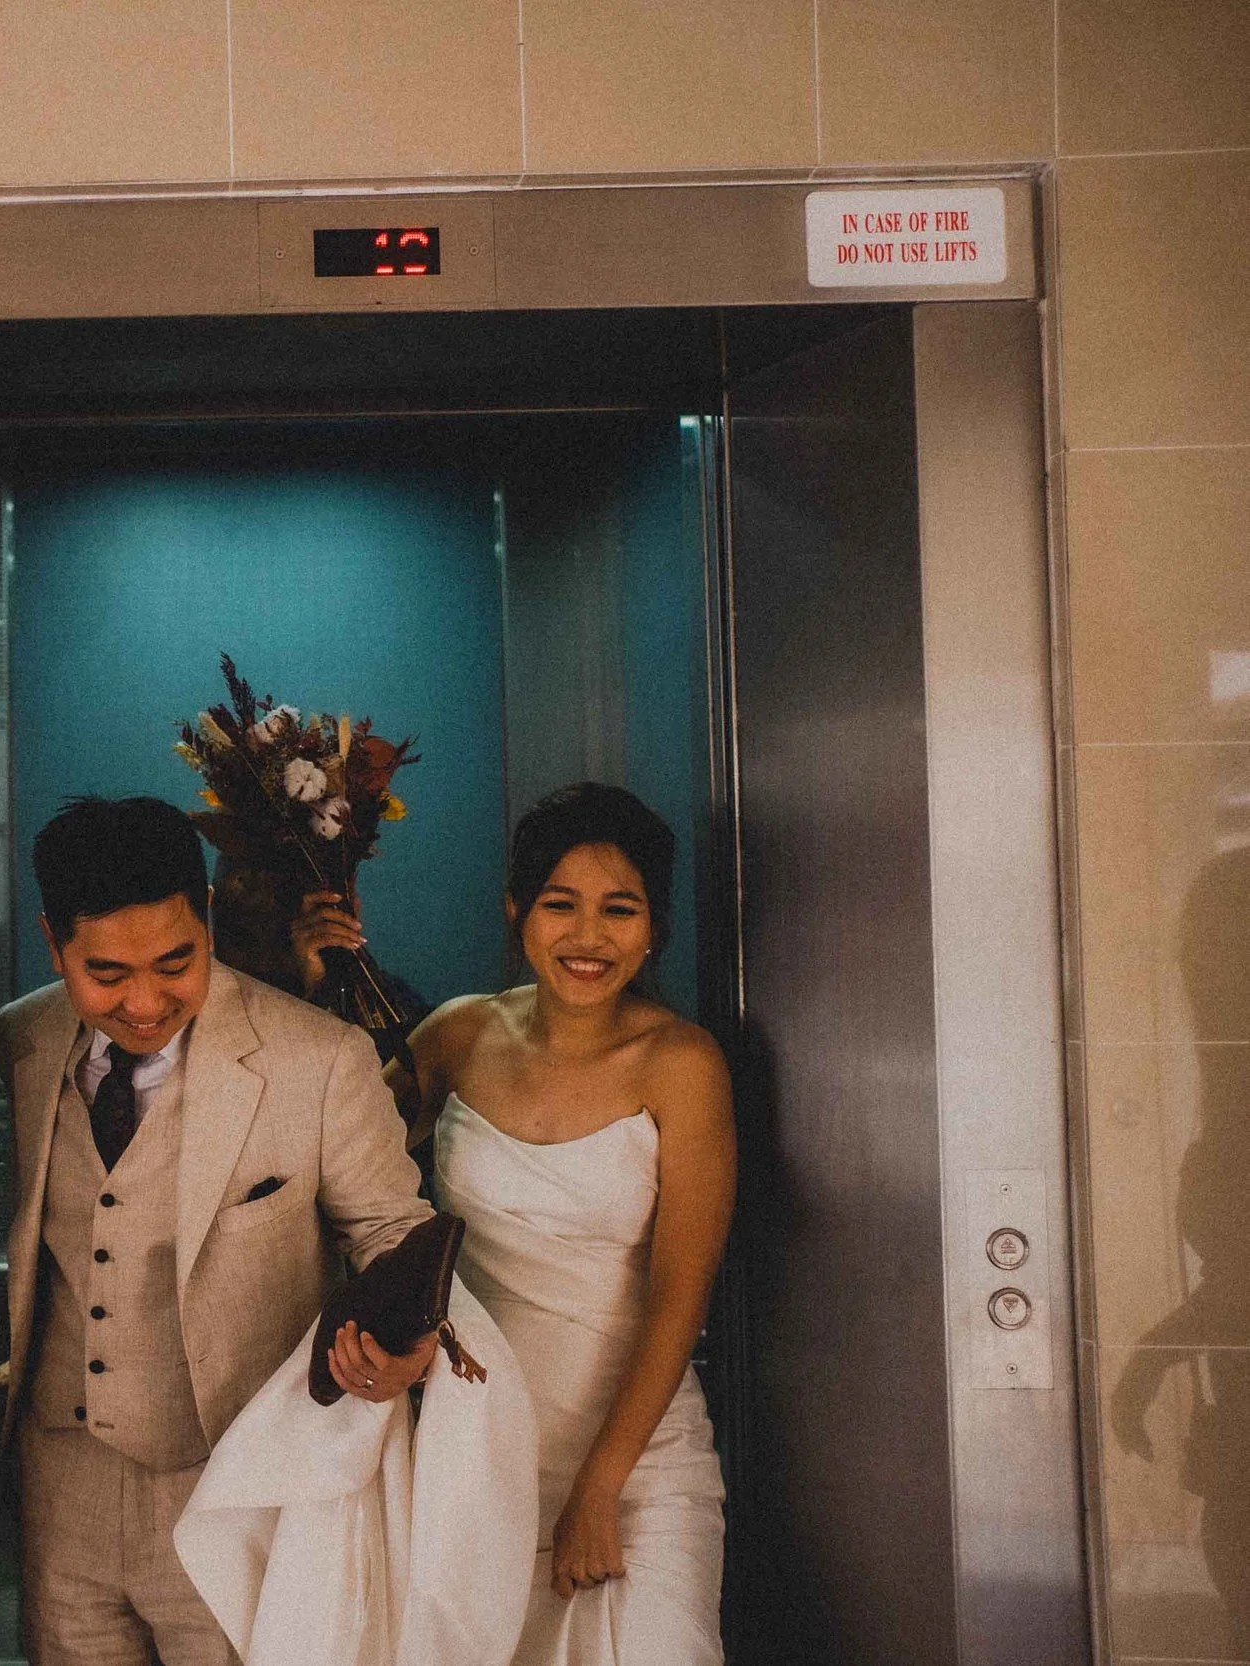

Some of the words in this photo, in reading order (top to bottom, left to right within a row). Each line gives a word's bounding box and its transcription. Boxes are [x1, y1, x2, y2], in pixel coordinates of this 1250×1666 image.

[842, 213, 858, 234] IN
[864, 212, 902, 233] CASE
[909, 212, 928, 232] OF
[934, 211, 969, 232] FIRE
[837, 244, 859, 264] DO
[864, 242, 894, 263] NOT
[901, 242, 928, 263] USE
[935, 241, 977, 262] LIFTS
